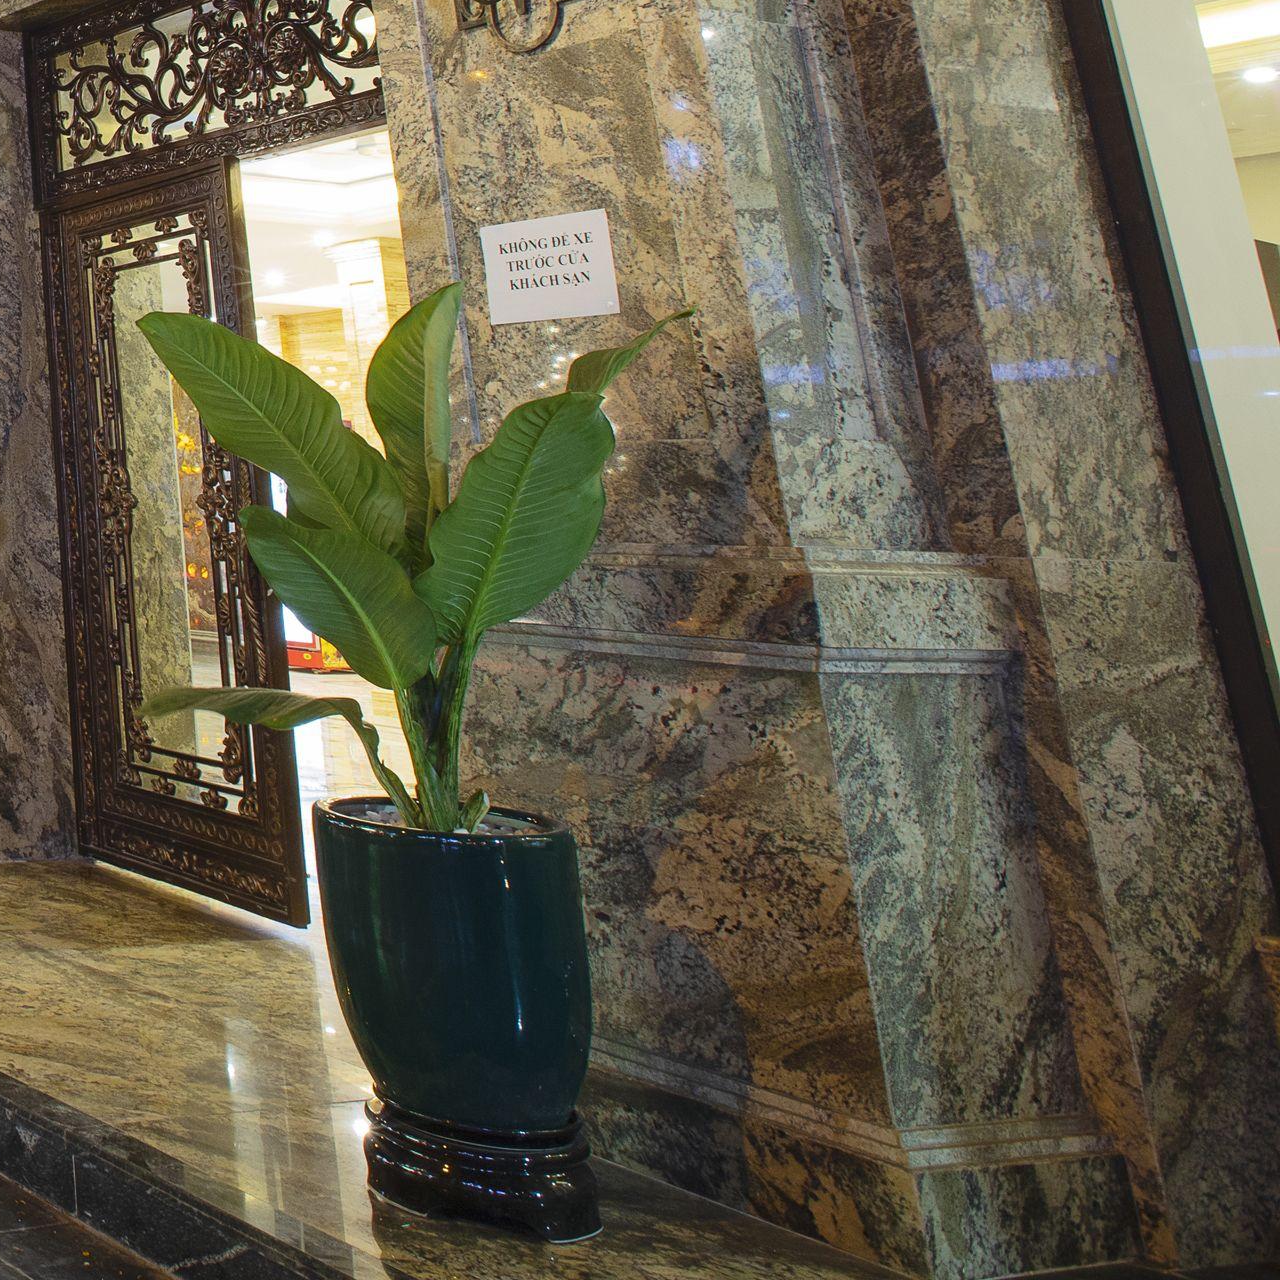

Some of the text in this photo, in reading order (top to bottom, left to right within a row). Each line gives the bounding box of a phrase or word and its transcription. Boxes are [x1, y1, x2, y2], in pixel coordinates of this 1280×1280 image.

[498, 237, 548, 255] KHÔNG
[574, 231, 594, 244] XE
[506, 254, 555, 272] TRƯỚC
[510, 271, 591, 290] KHÁCH SẠN
